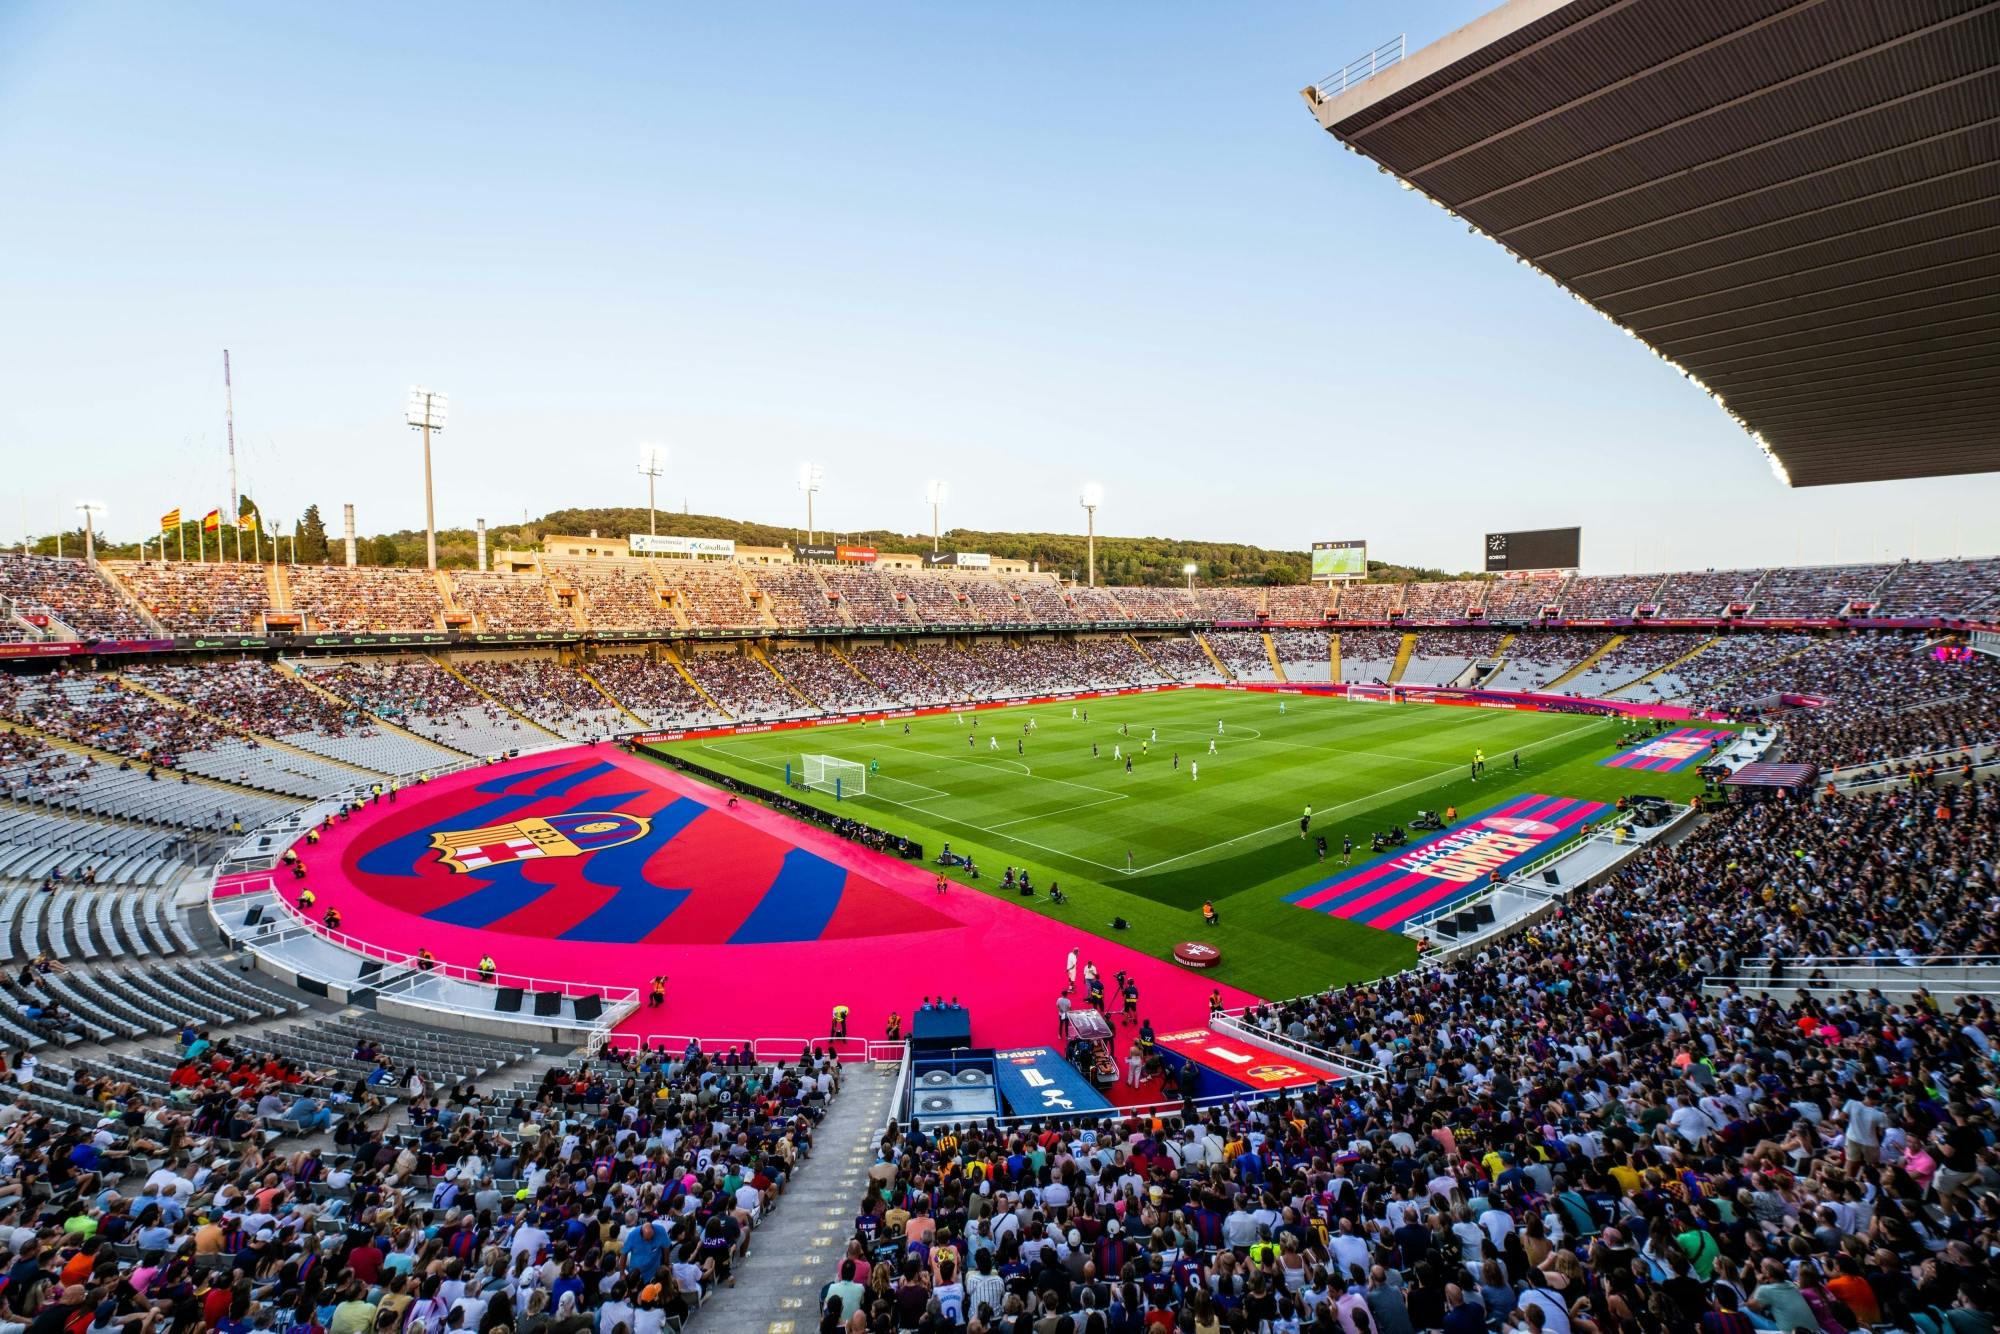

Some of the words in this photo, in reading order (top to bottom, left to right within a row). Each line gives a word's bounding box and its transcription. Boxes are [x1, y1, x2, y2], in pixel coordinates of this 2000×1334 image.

[698, 542, 731, 551] CaixaBank
[643, 735, 666, 743] ESTRELLA
[527, 827, 565, 846] FCB
[1417, 833, 1543, 883] GAMPER
